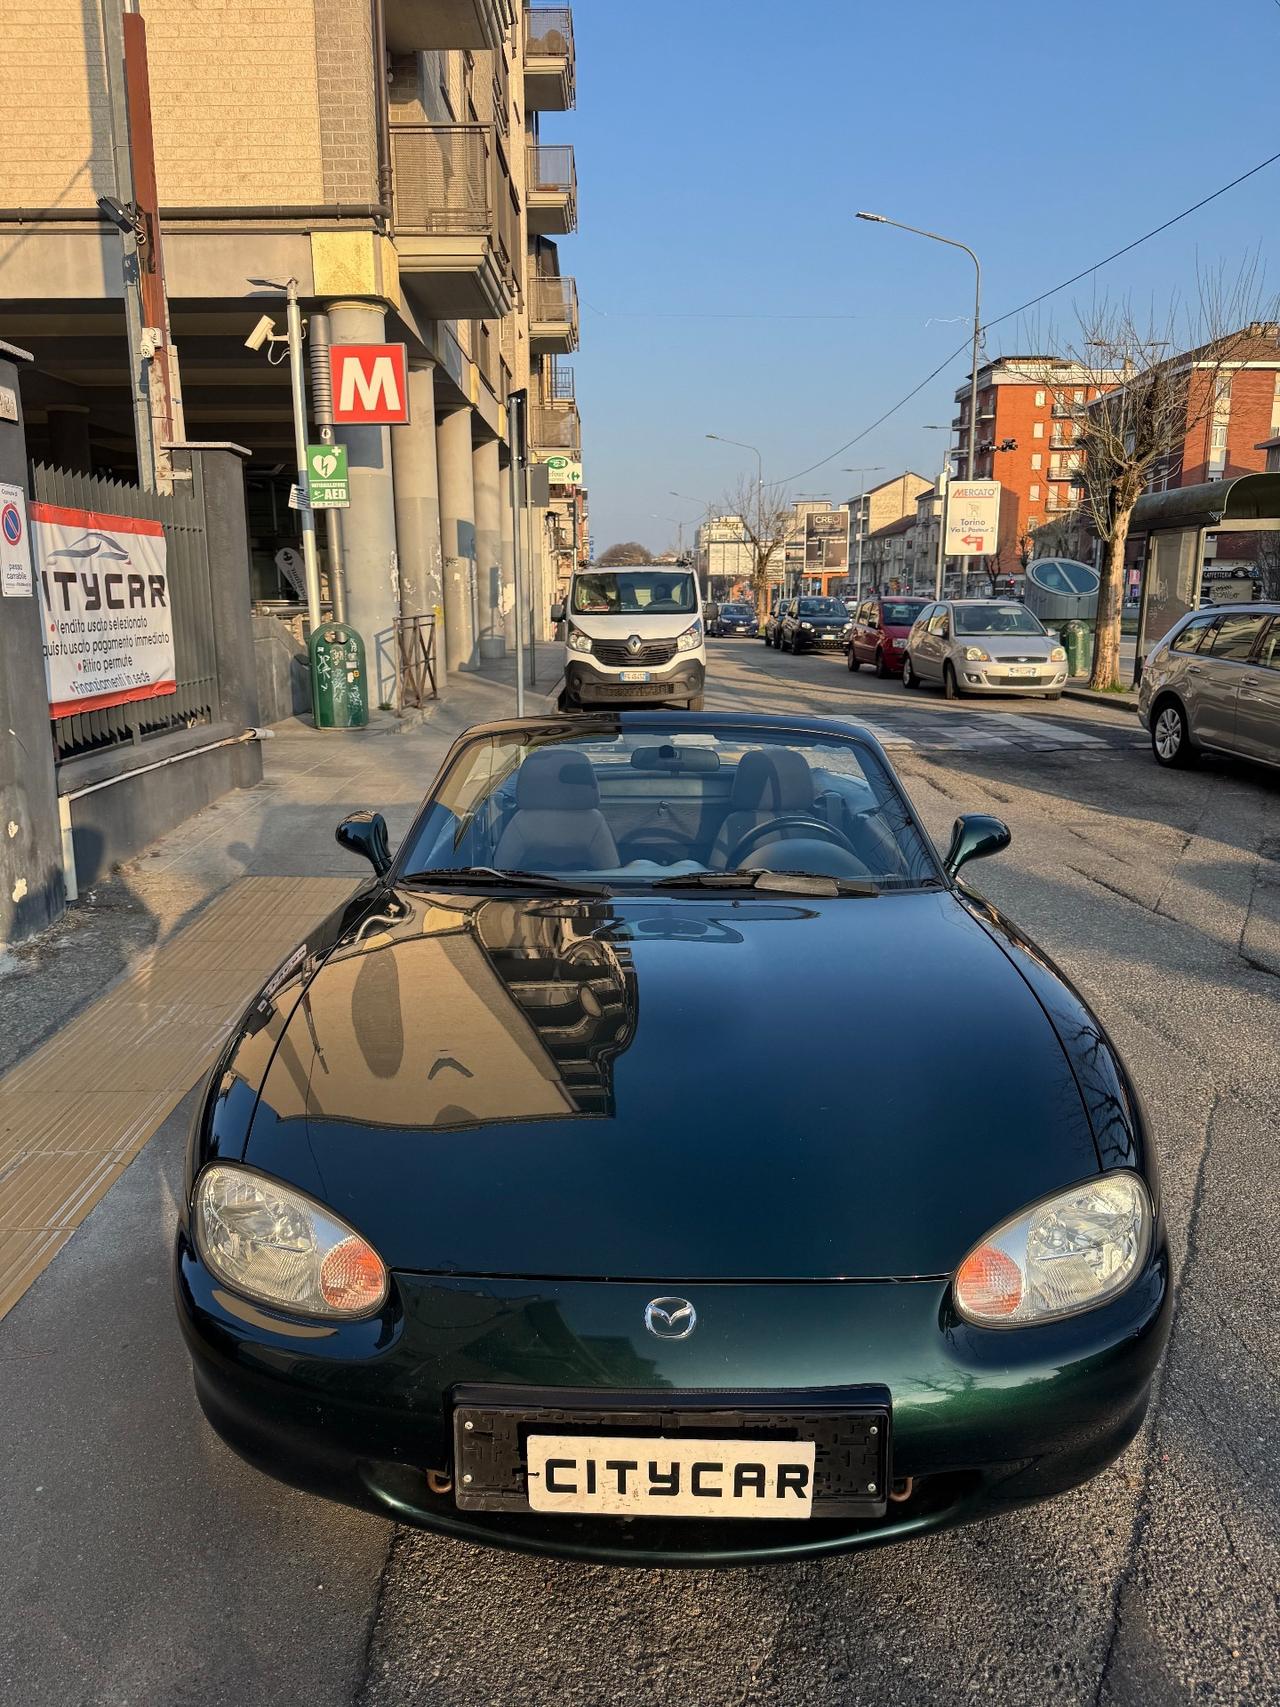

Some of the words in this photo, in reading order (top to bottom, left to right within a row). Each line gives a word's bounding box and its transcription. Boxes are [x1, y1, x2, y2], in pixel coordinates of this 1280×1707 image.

[338, 356, 401, 412] M
[324, 488, 347, 500] AED
[815, 516, 840, 524] CREO
[960, 518, 986, 526] Torino
[7, 572, 27, 580] carrabile
[41, 570, 167, 612] ITYCAR
[87, 618, 108, 633] usato
[108, 615, 148, 631] selezionato
[68, 638, 91, 655] usato
[92, 635, 134, 655] pagamento
[134, 633, 170, 648] immediato
[82, 658, 102, 673] Ritiro
[103, 655, 133, 673] permute
[72, 674, 124, 694] Finanziamenti
[125, 673, 132, 685] in
[132, 670, 151, 684] sede
[545, 1457, 810, 1499] CITYCAR
